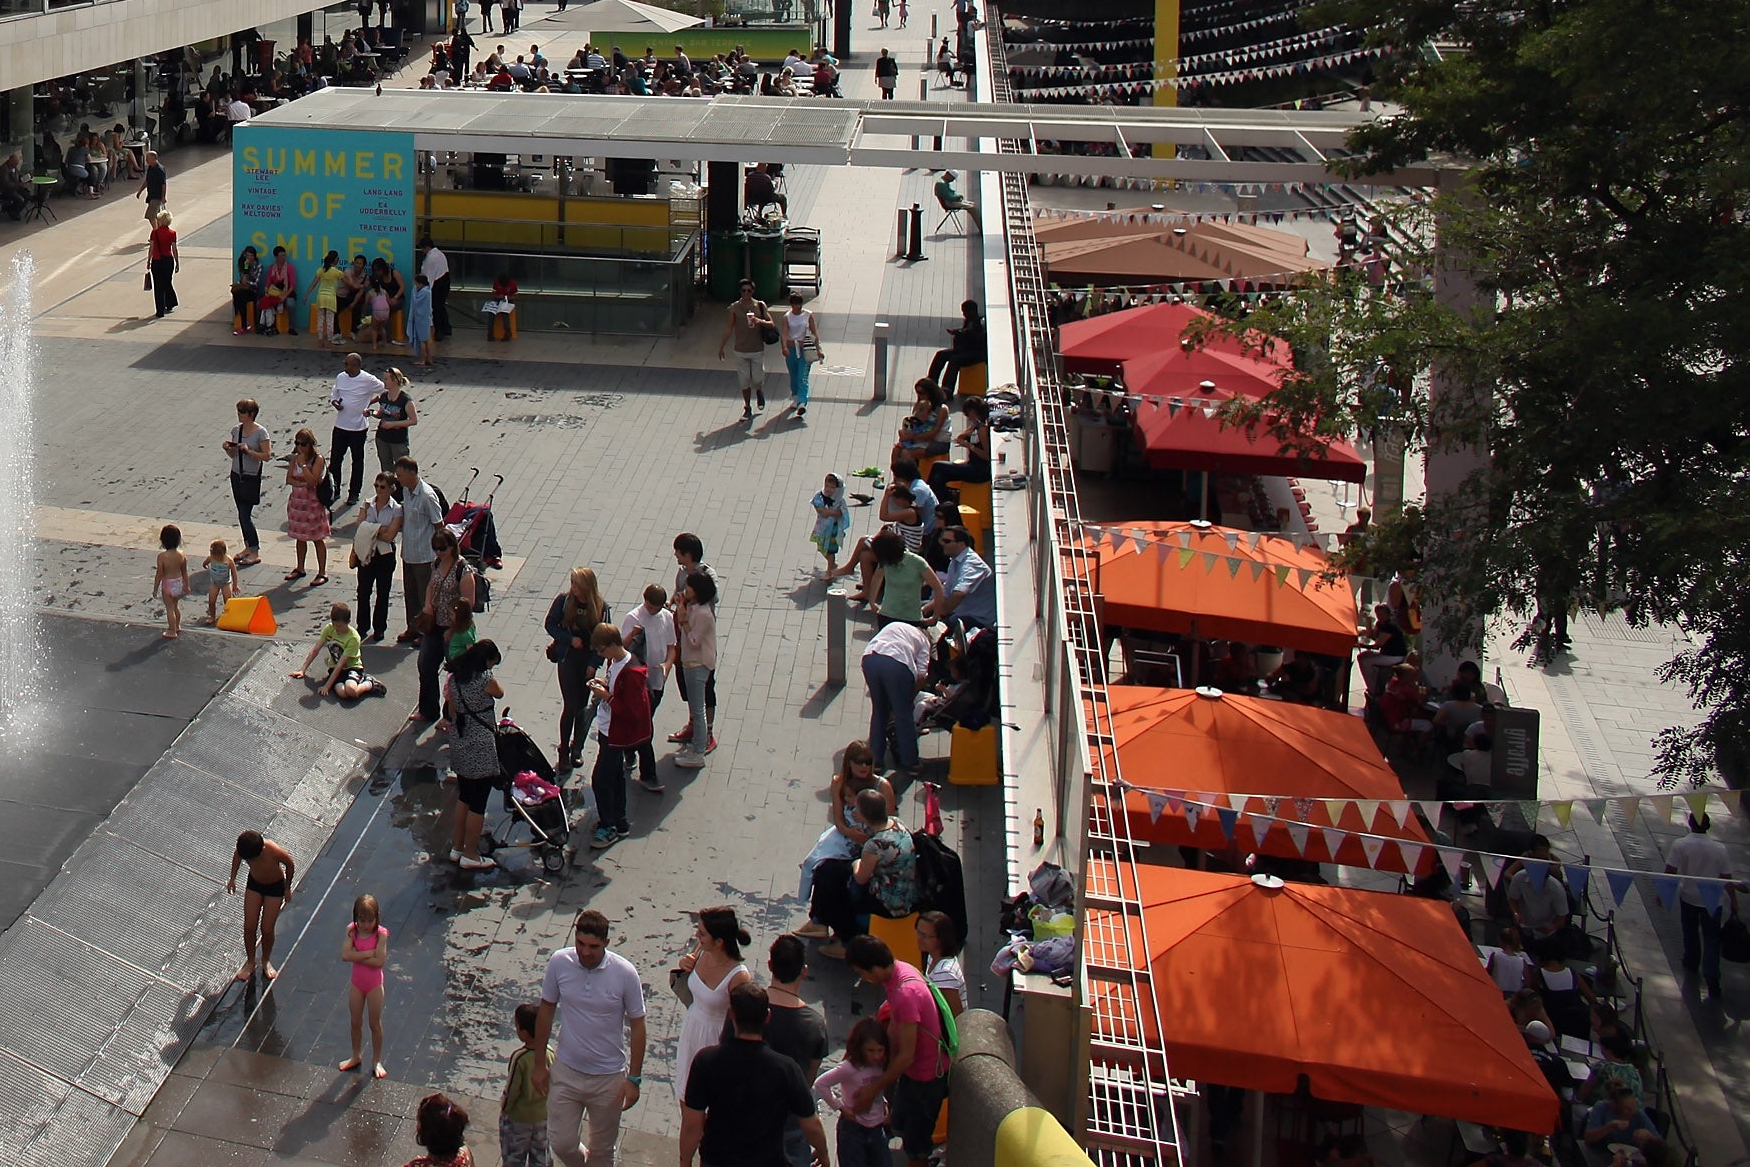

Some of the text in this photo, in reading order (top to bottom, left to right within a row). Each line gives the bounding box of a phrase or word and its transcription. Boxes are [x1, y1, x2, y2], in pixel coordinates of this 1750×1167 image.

[241, 145, 404, 180] SUMMER
[248, 187, 277, 195] VINTAGE
[363, 188, 403, 197] LANG LANG
[299, 191, 346, 220] OF
[243, 210, 281, 218] MELTDOWN
[359, 208, 407, 216] UDDERBELLY
[359, 223, 407, 232] TRACEY EMIN
[1503, 728, 1530, 777] giraffe
